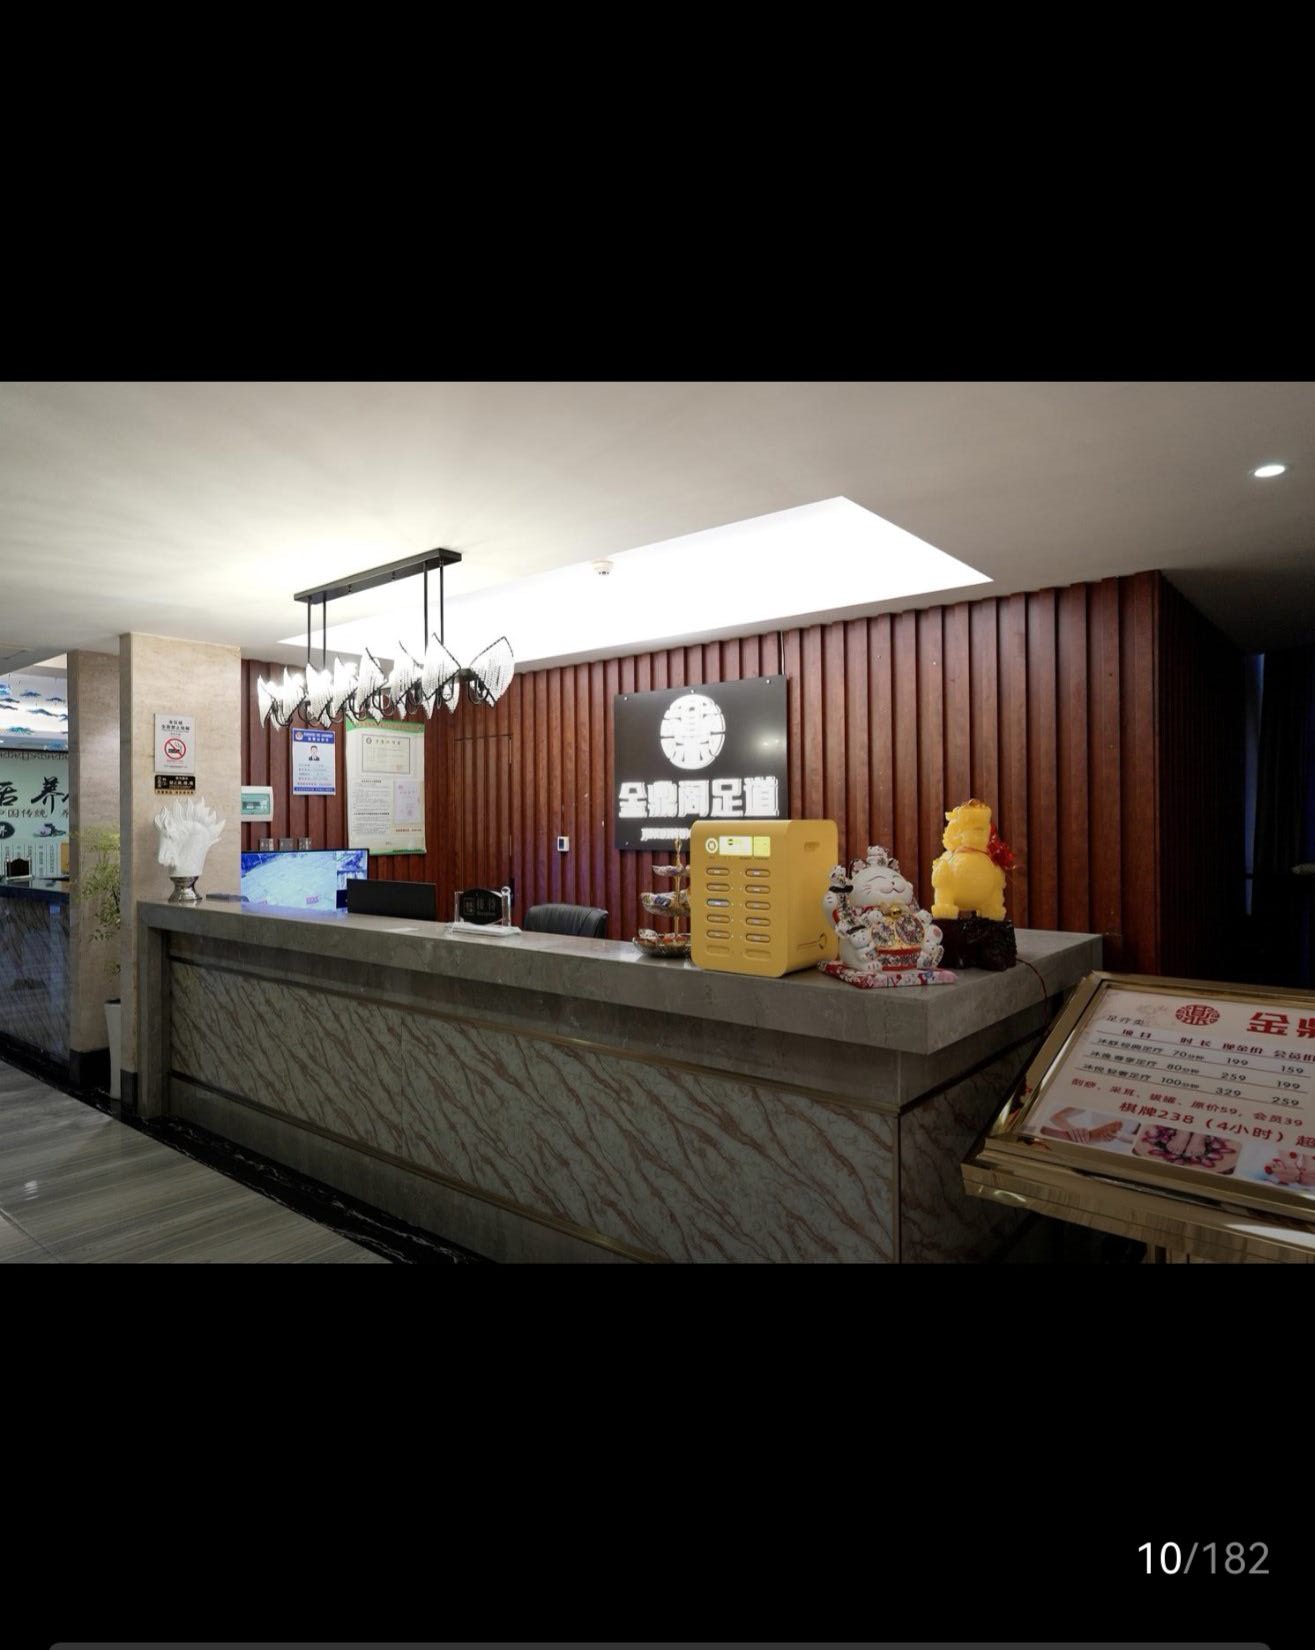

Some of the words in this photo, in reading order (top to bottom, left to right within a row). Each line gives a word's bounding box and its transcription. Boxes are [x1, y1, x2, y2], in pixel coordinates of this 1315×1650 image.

[1226, 1057, 1249, 1066] 199
[1281, 1065, 1305, 1075] 159
[1221, 1071, 1247, 1081] 259
[1276, 1080, 1301, 1090] 199
[1215, 1087, 1242, 1097] 329
[1271, 1096, 1300, 1107] 259
